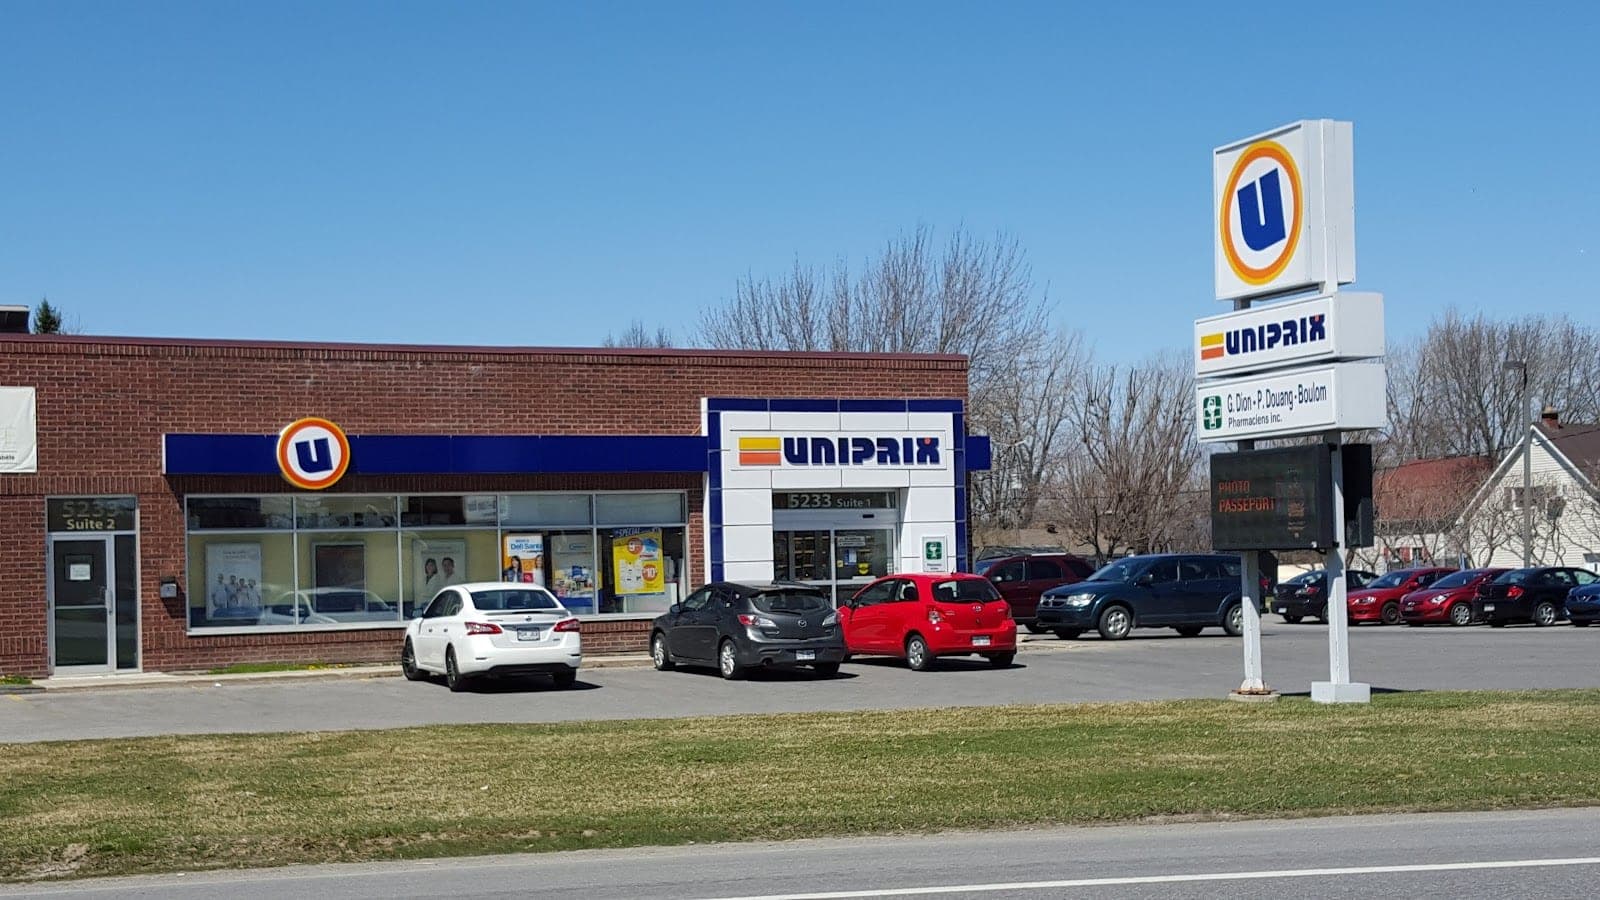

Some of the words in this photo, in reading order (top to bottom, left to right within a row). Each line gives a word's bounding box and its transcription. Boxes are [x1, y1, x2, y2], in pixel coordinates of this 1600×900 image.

[1226, 313, 1325, 355] UNIPRIX
[1227, 394, 1235, 413] G.
[1236, 391, 1252, 412] Dion
[1228, 413, 1269, 428] Pharmaciens
[783, 437, 940, 465] UNIPRIX
[1219, 481, 1249, 494] PHOTO
[791, 493, 832, 508] 5233
[836, 497, 864, 508] Suite
[1219, 498, 1274, 512] PASSEPORT
[66, 518, 104, 530] Suite
[106, 518, 116, 530] 2
